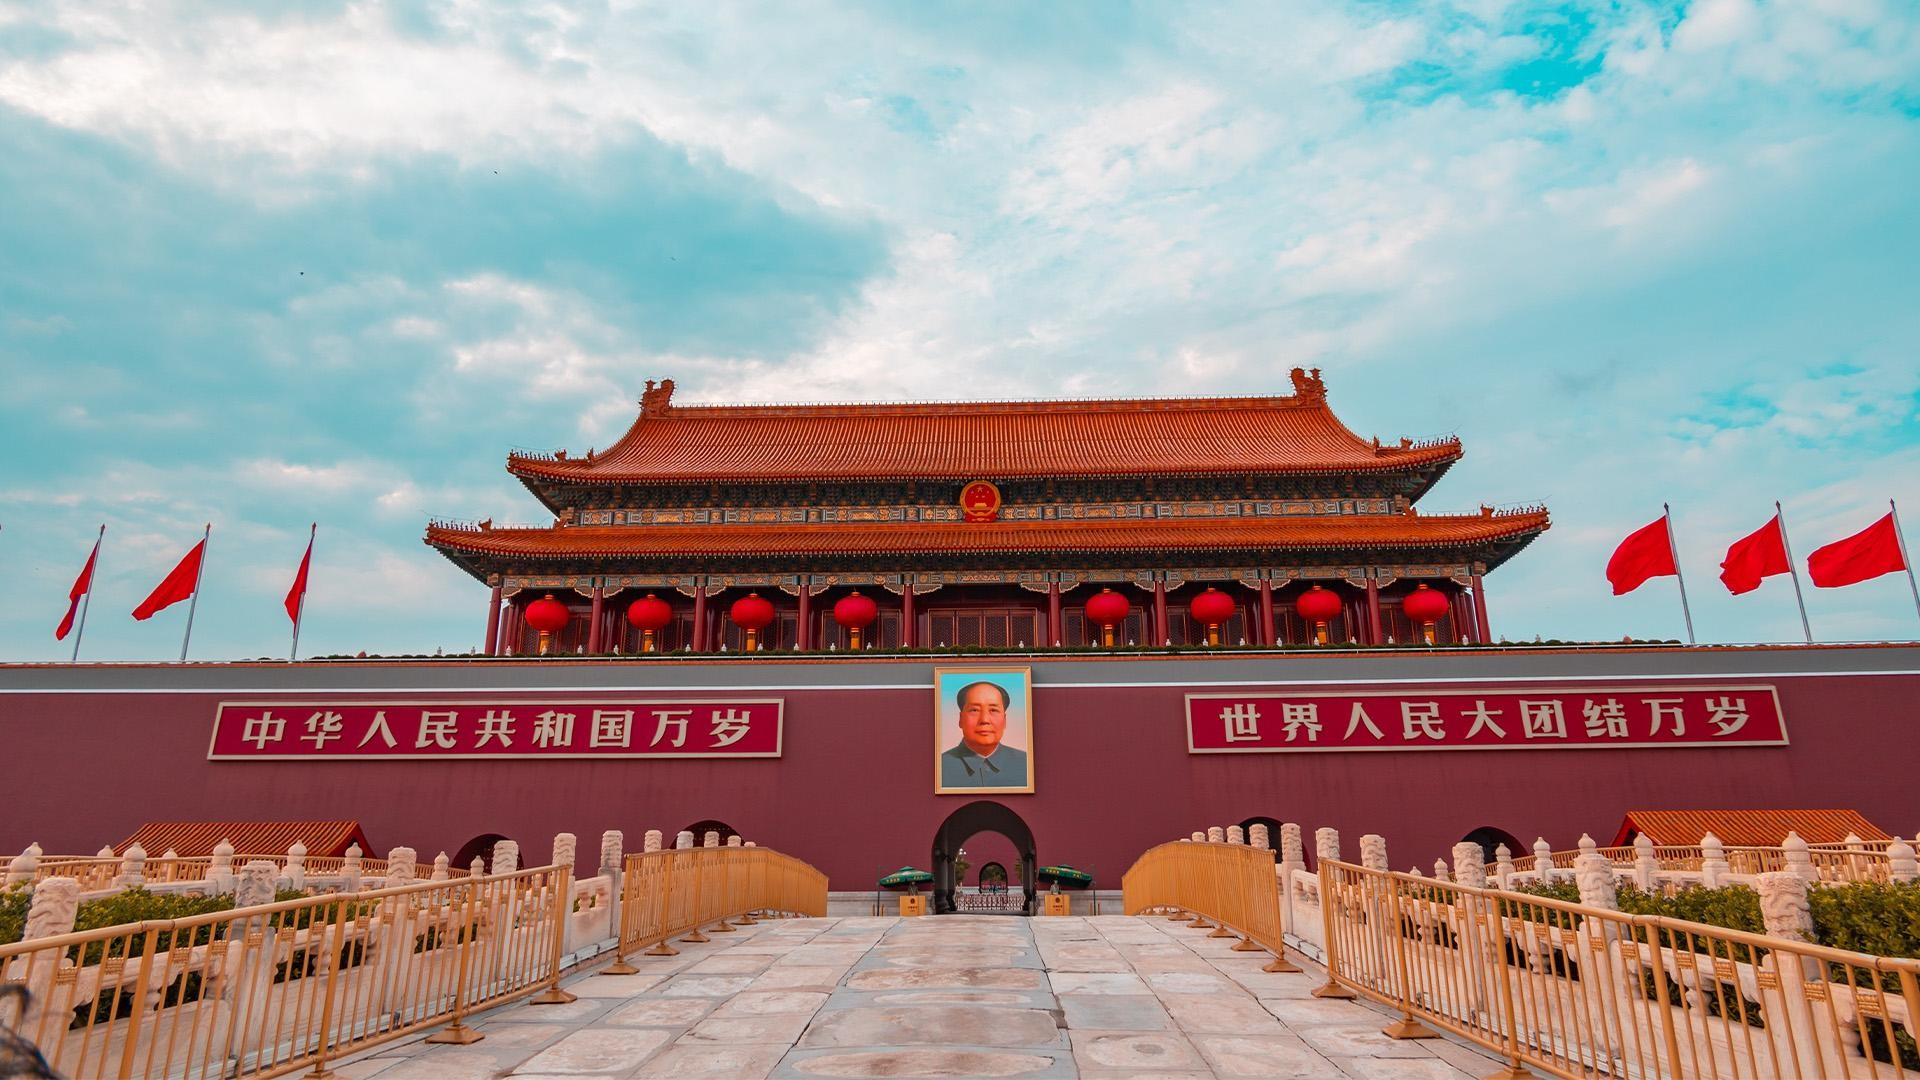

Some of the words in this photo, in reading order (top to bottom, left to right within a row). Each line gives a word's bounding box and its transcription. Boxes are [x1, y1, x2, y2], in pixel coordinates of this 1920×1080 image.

[242, 709, 751, 749] 中华人民共和国万岁
[1219, 697, 1749, 742] 世界人民大团结万岁
